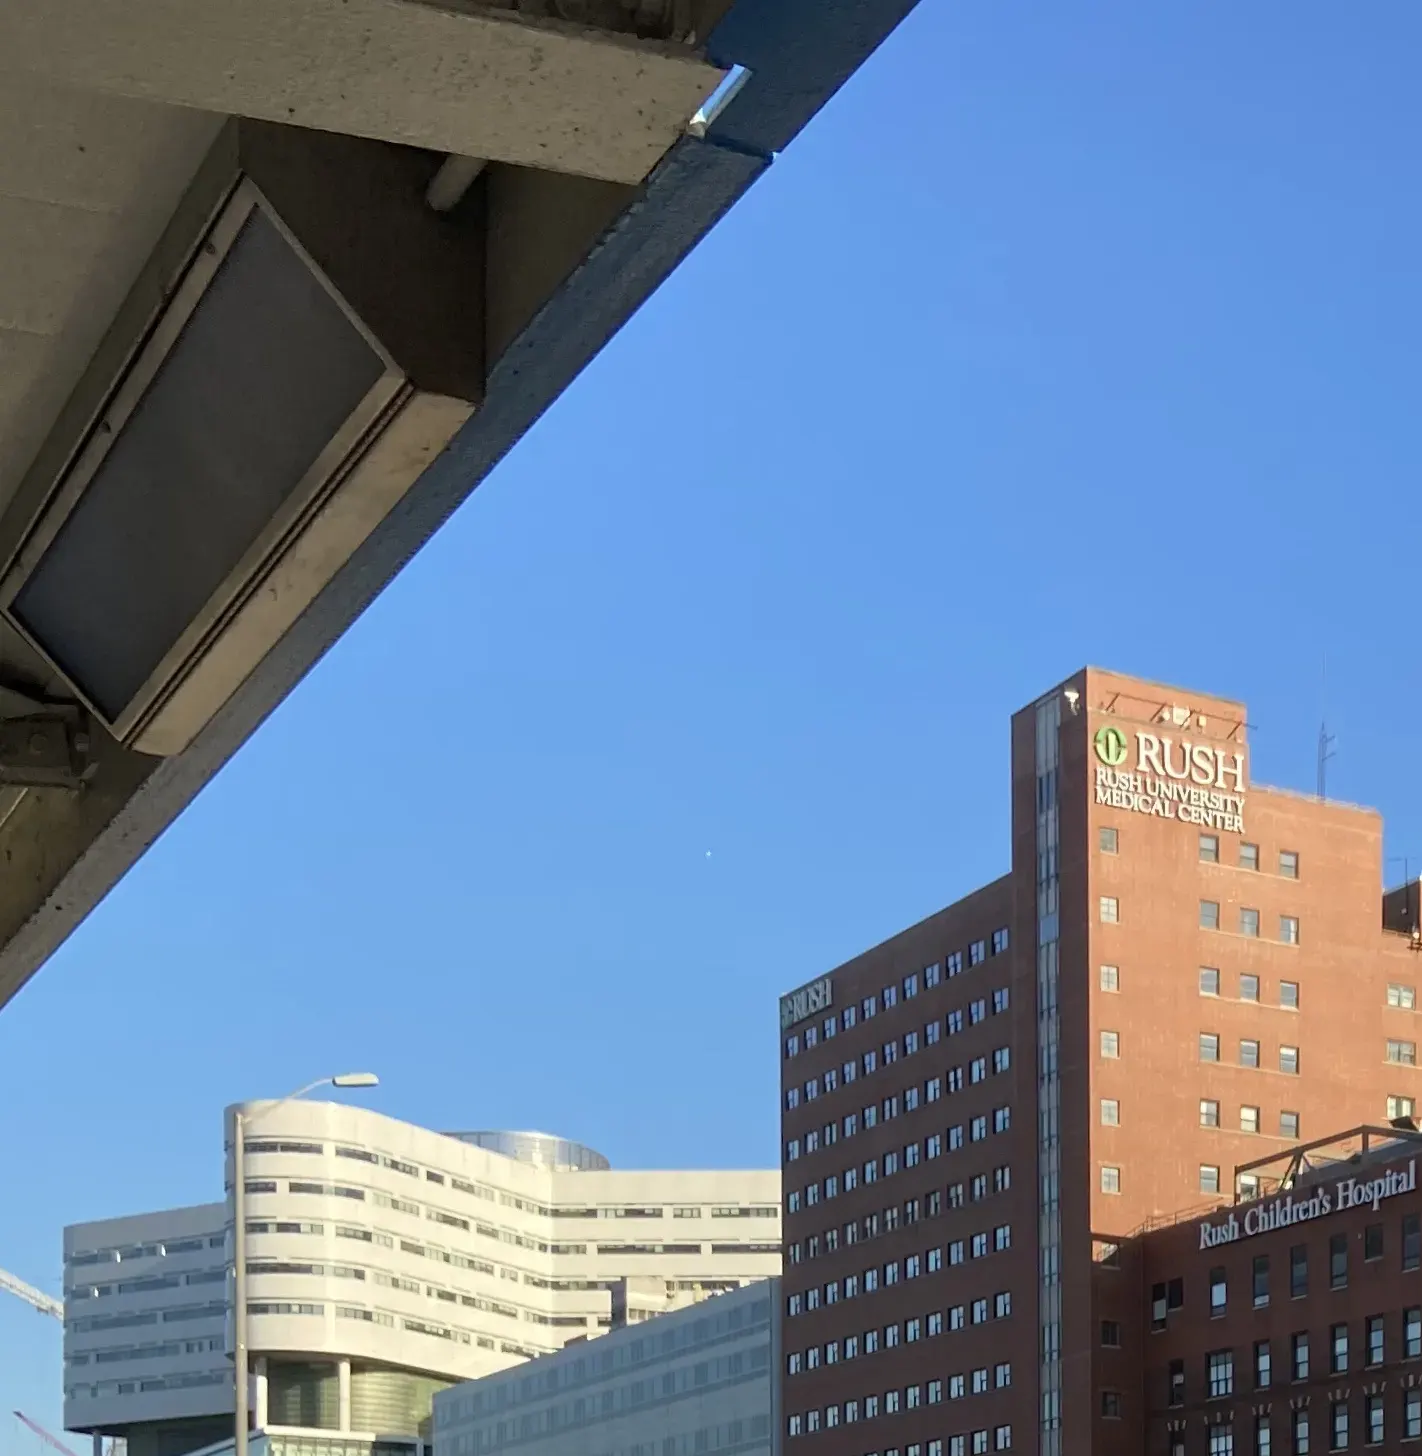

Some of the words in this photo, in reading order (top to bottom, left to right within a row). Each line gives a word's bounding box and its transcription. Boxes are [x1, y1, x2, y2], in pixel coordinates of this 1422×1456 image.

[1135, 732, 1246, 792] RUSH
[1095, 765, 1142, 793] RUSH
[1145, 777, 1246, 815] UNIVERSITY
[1095, 786, 1175, 819] MEDICAL
[1177, 804, 1246, 834] CENTER
[1199, 1212, 1240, 1250] Rush
[1244, 1187, 1331, 1236] Children's
[1336, 1159, 1417, 1211] Hospital
